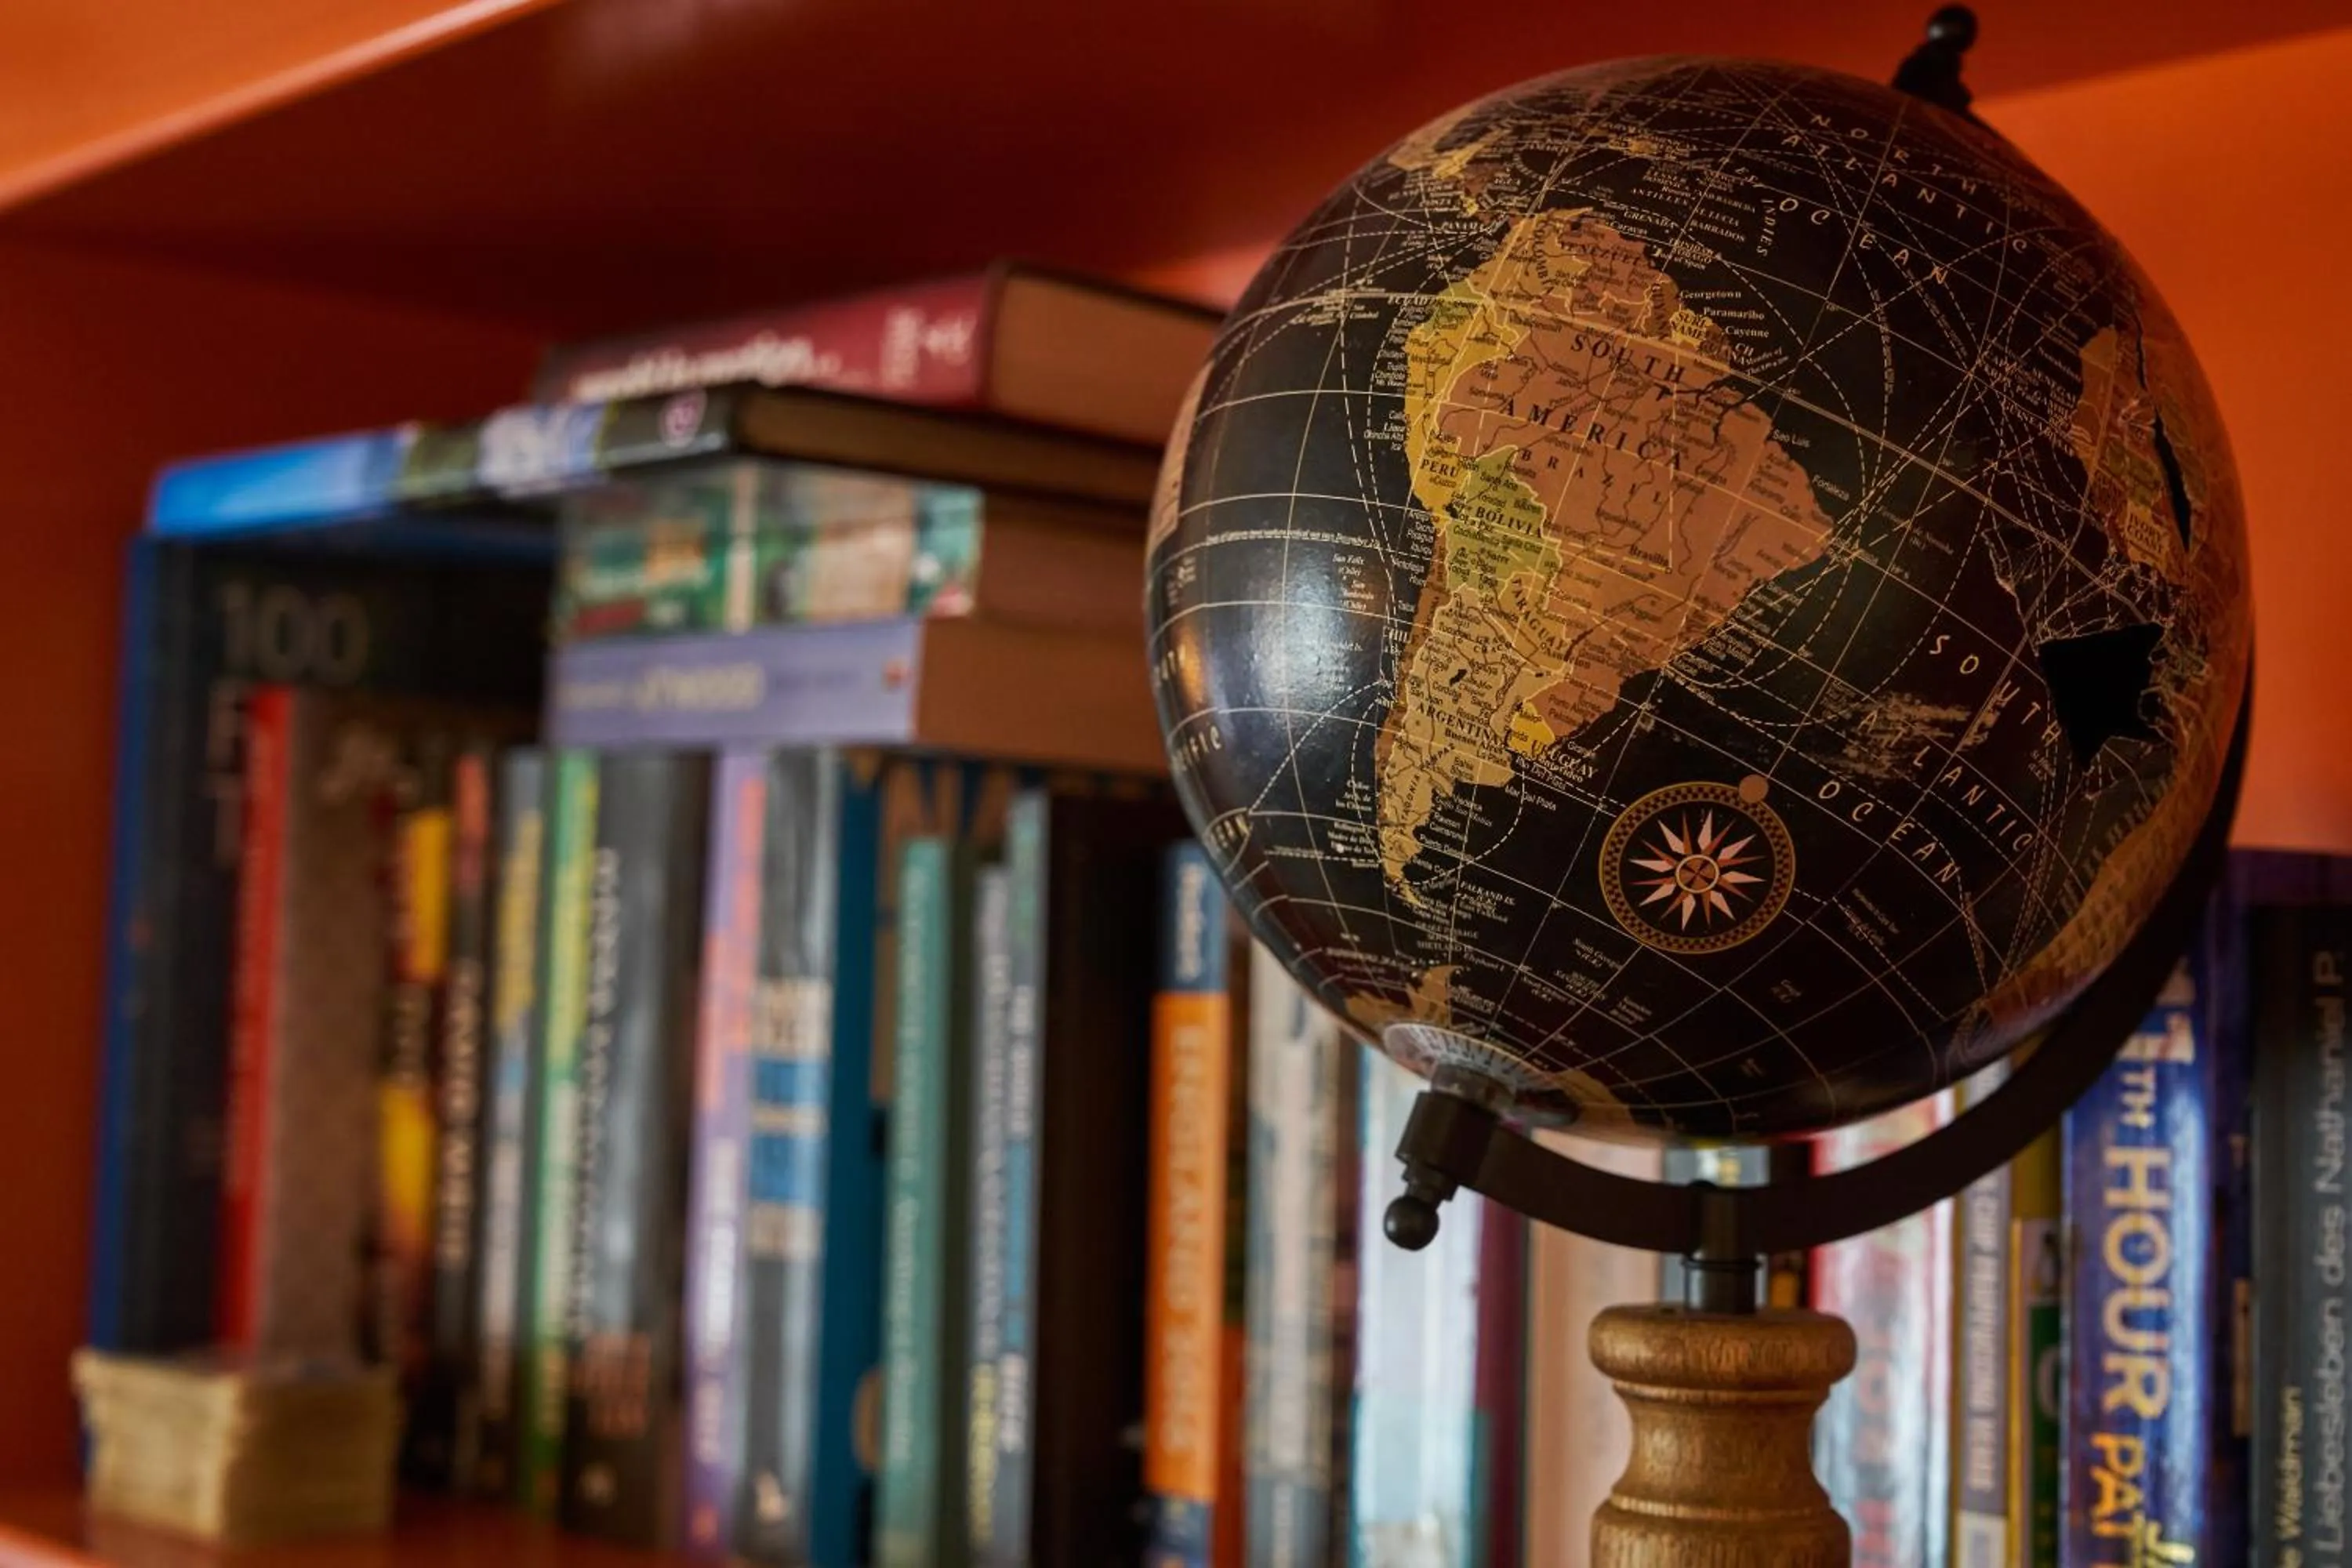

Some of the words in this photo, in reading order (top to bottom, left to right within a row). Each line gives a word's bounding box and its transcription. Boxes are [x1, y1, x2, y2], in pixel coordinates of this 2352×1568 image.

[1782, 132, 2028, 253] ATLANTIC
[1810, 113, 1978, 195] NORTH
[1778, 196, 1948, 285] OCEAN
[1680, 289, 1742, 301] Georgetown
[1704, 307, 1765, 321] Paramaribo
[1725, 325, 1769, 339] Cayenne
[1570, 334, 1686, 384] SOUTH
[1420, 458, 1459, 478] PERU
[1501, 399, 1684, 471] AMERICA
[1521, 449, 1662, 504] BRAZIL
[1475, 506, 1542, 539] BOLIVIA
[218, 583, 371, 687] 100
[1929, 633, 2061, 744] SOUTH
[1858, 712, 2033, 852] ATLANTIC
[1817, 782, 1960, 883] OCEAN
[2310, 996, 2347, 1195] Nathaniel
[2102, 1145, 2173, 1421] HOUR
[2311, 1204, 2347, 1287] des
[2275, 1385, 2304, 1539] Waldman
[2310, 1298, 2347, 1554] Liebesleben
